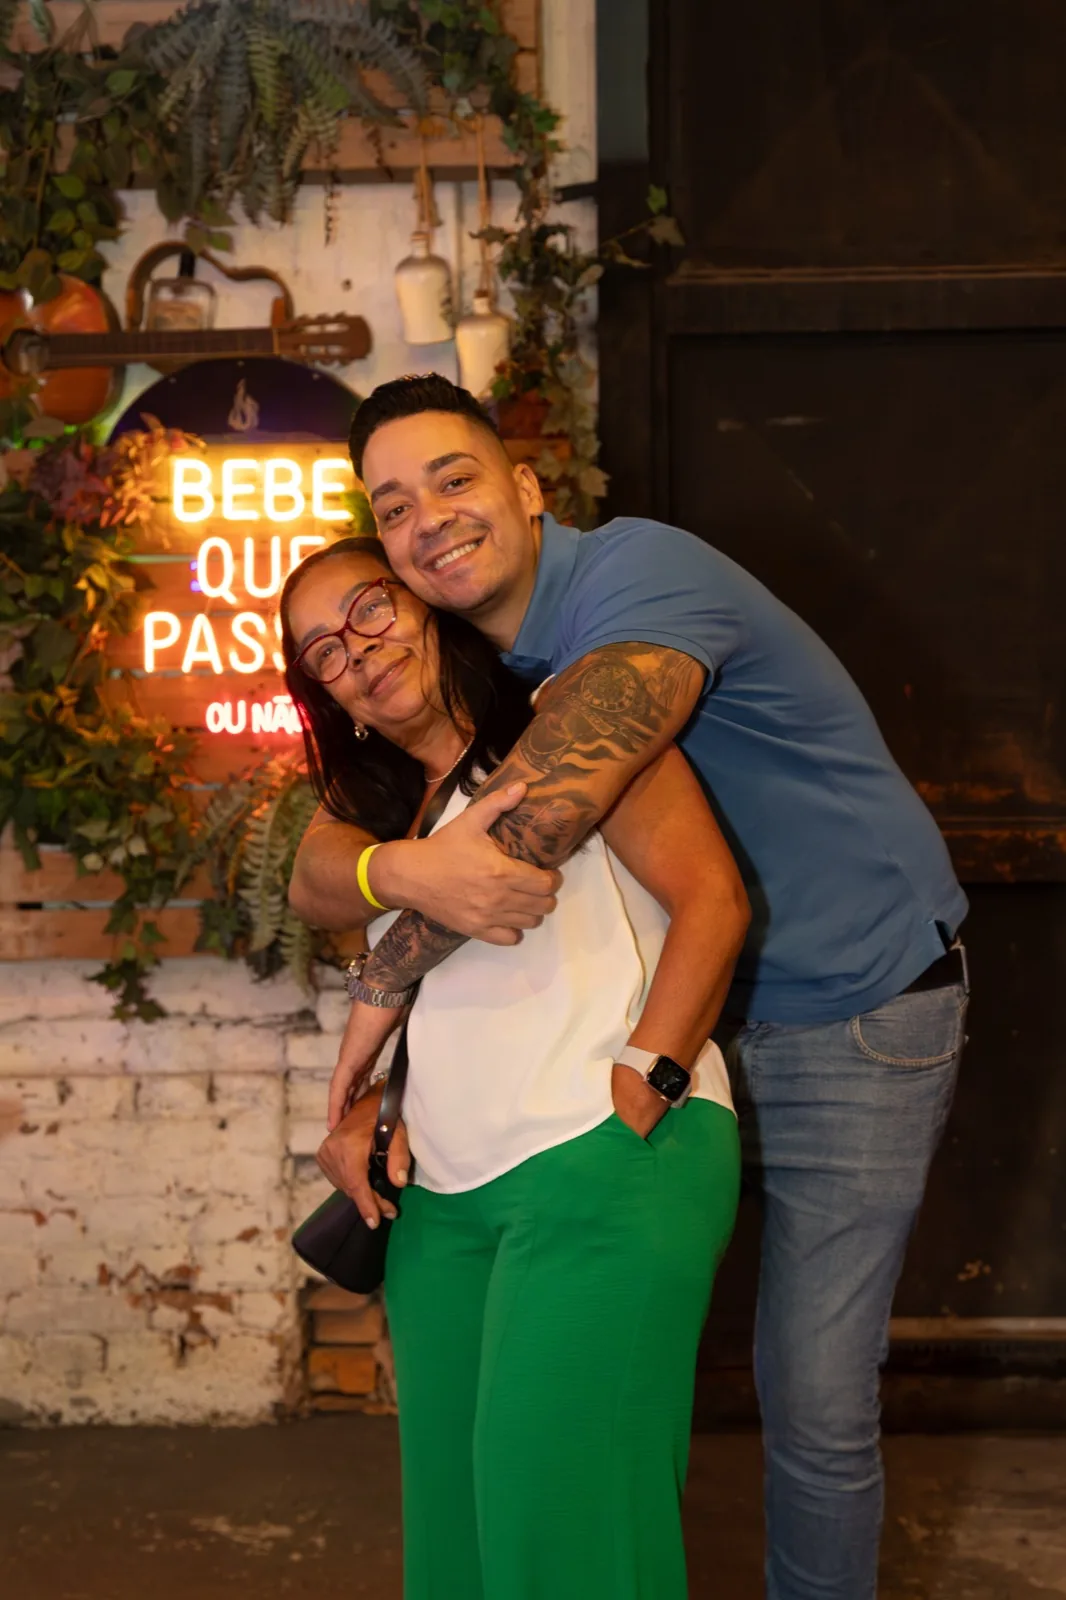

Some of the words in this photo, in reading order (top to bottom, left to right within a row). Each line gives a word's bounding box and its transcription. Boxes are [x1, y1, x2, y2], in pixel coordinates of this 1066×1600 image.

[173, 458, 353, 522] BEBE
[143, 611, 287, 674] PAS
[205, 699, 246, 734] OU
